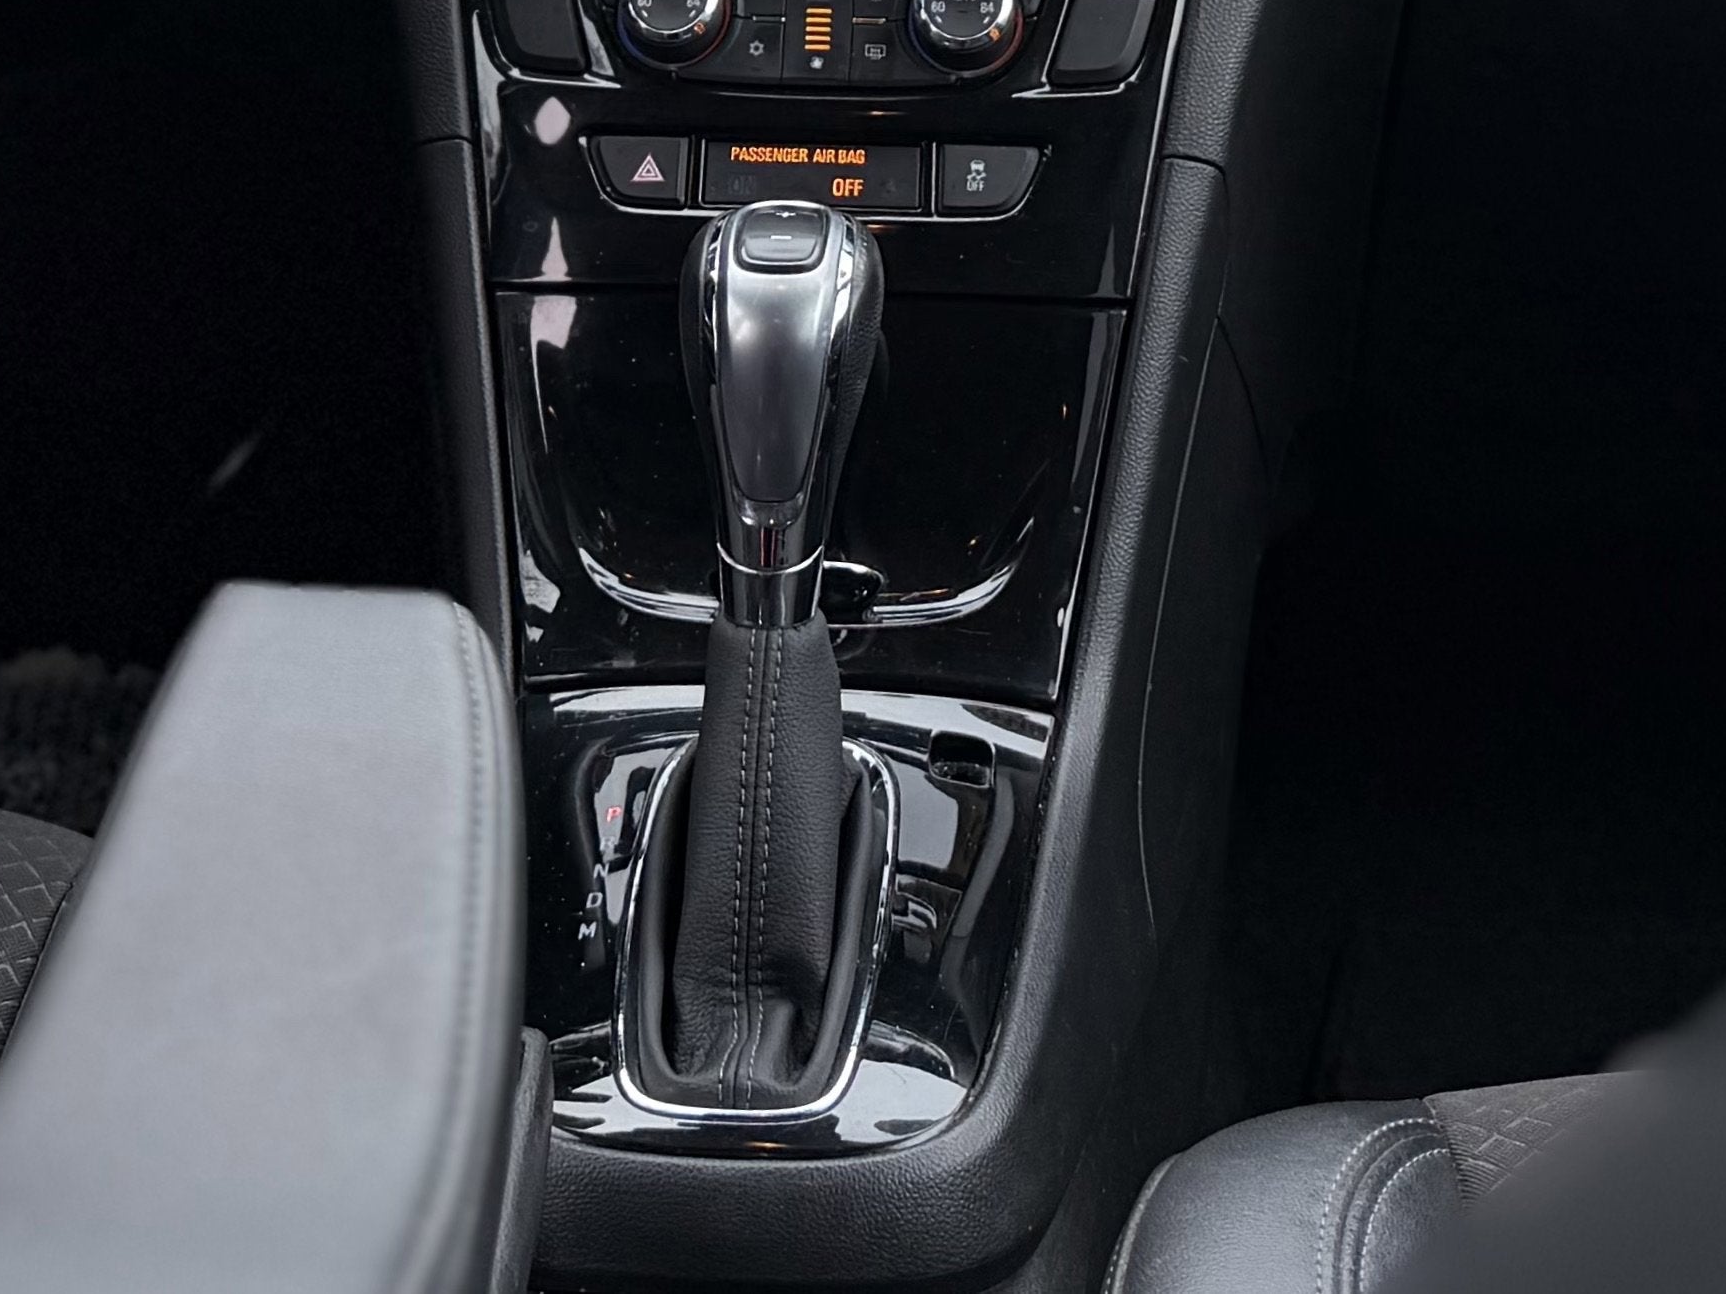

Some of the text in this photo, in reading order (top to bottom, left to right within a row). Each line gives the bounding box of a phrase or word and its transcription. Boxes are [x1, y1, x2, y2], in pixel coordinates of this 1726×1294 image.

[980, 2, 995, 14] 84
[731, 146, 866, 164] PASSENGER AIR BAG
[832, 178, 865, 197] OFF
[606, 806, 622, 823] P
[593, 863, 610, 879] N
[586, 892, 604, 909] D
[577, 921, 597, 941] M
